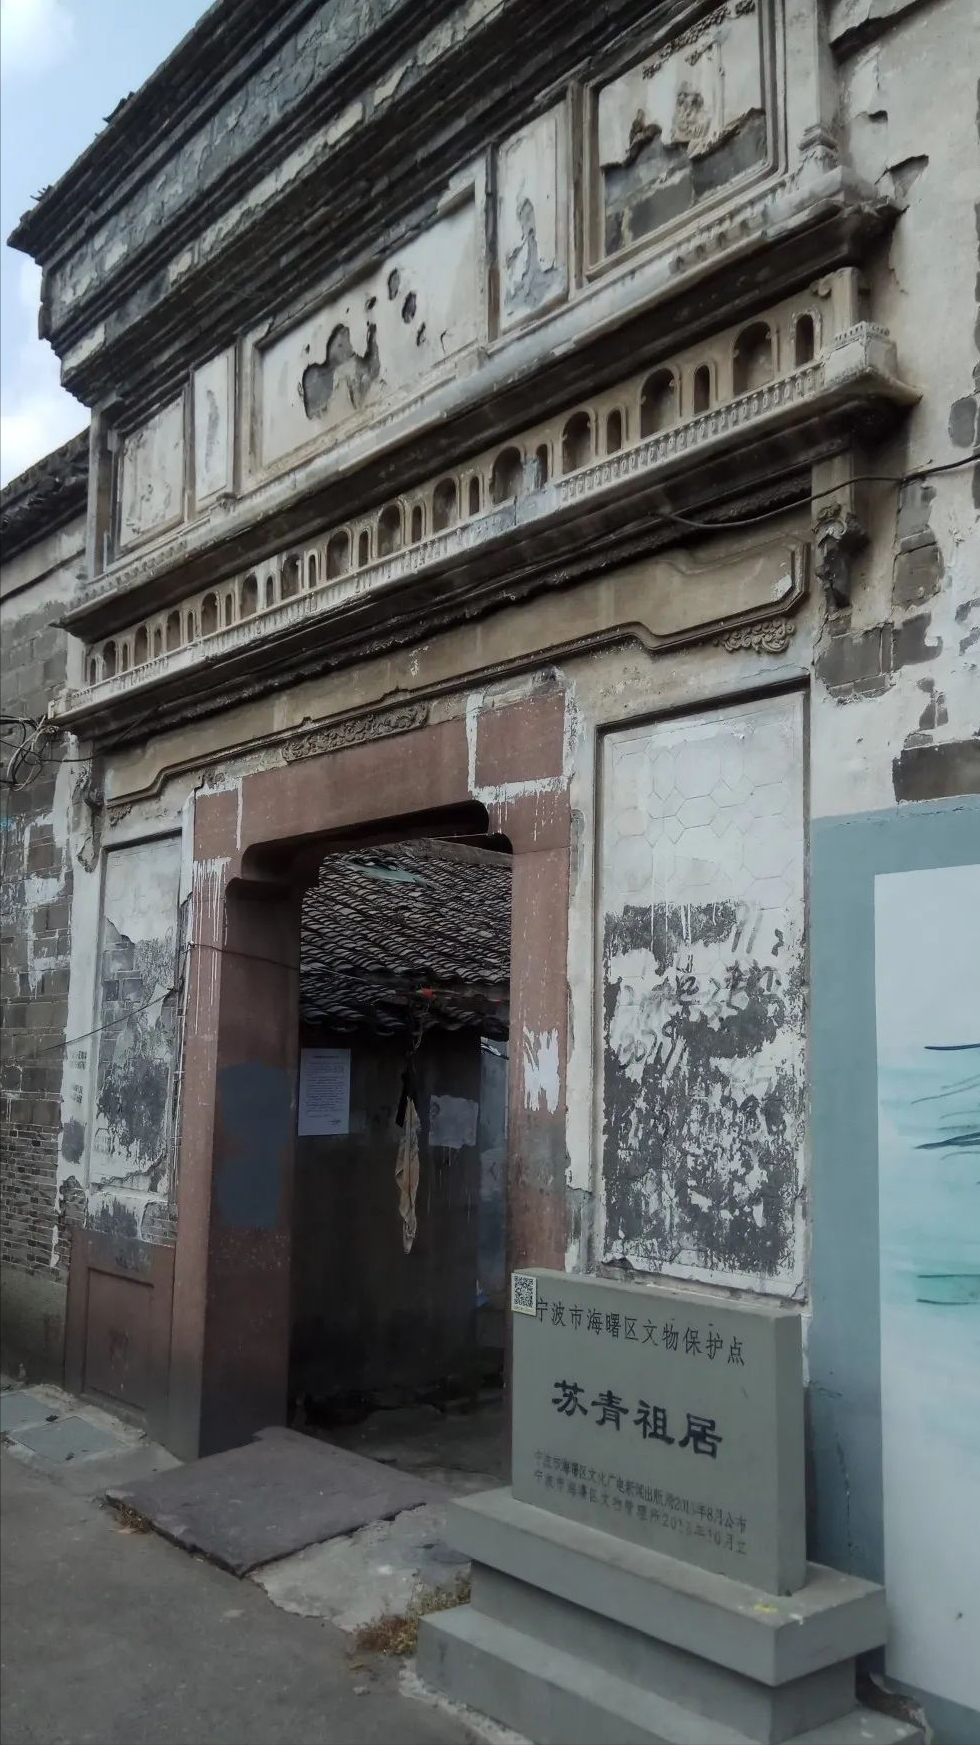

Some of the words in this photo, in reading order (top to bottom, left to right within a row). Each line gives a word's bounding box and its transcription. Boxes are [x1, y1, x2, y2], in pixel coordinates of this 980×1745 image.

[536, 1299, 745, 1366] 宁波市海曙区文物保护点
[552, 1380, 723, 1458] 苏青祖居
